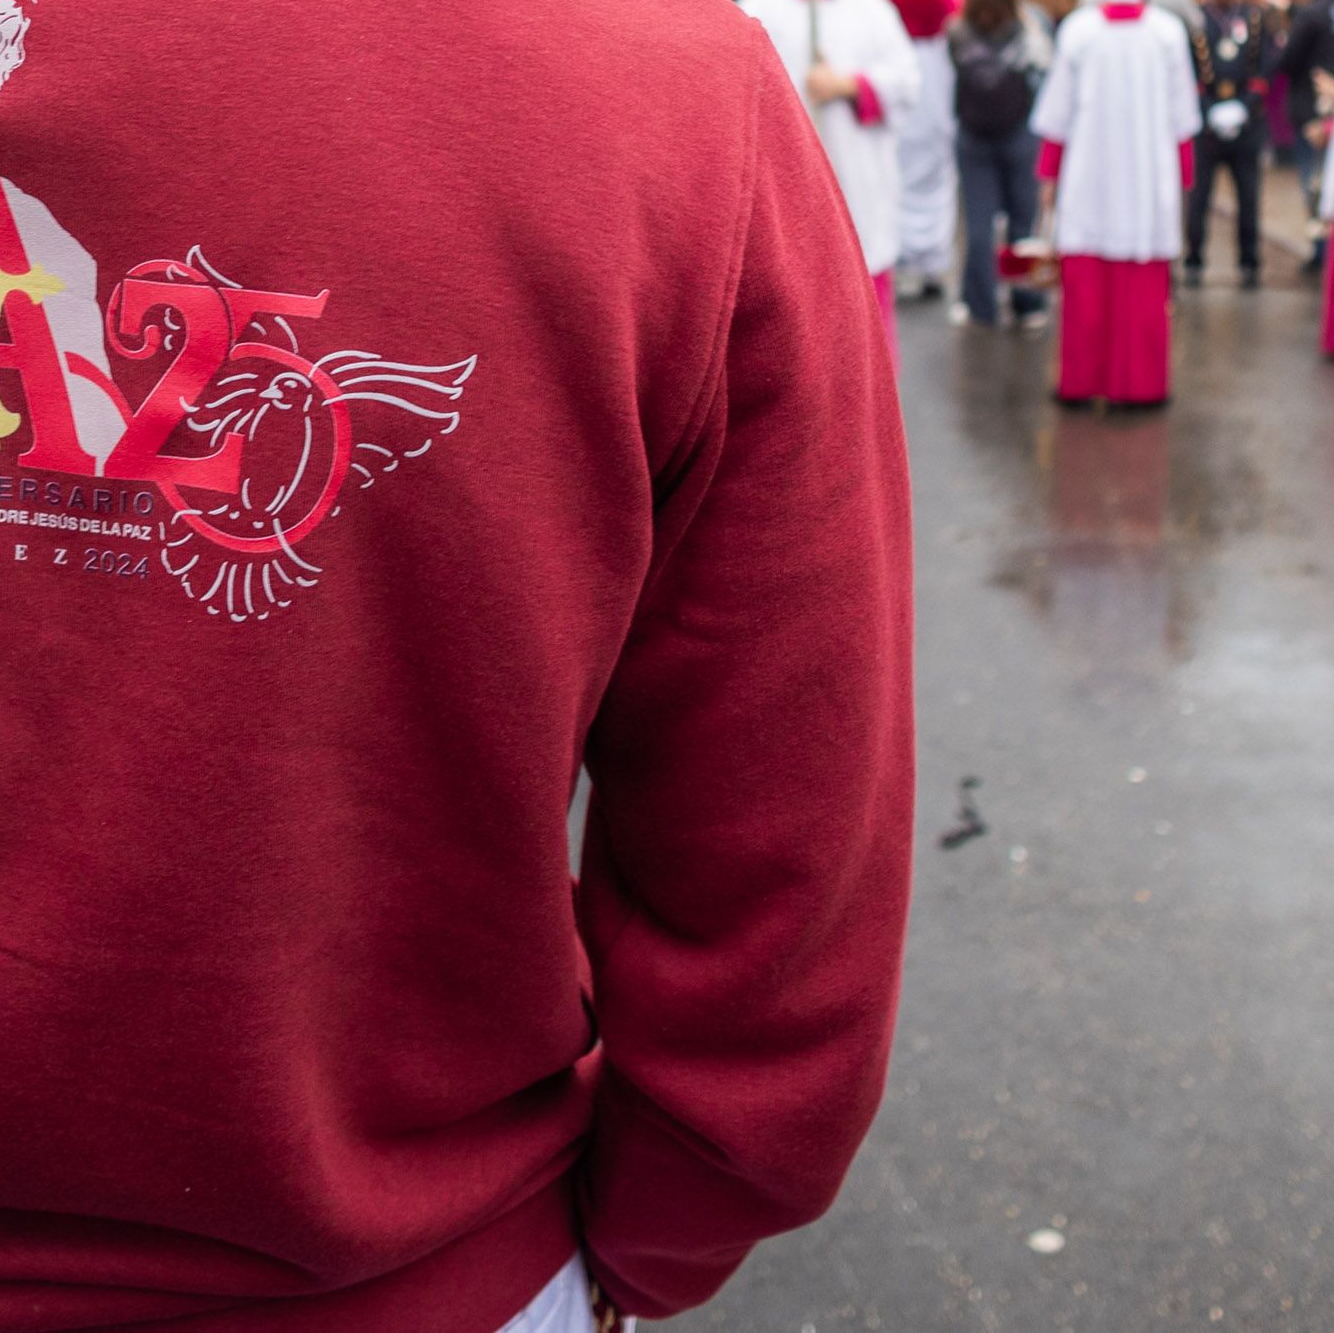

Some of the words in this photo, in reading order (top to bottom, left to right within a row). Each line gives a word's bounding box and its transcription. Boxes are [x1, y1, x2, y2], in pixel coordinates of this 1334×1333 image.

[29, 513, 78, 531] JESÚS
[79, 521, 100, 533] DE
[101, 523, 122, 537] LA
[122, 525, 152, 541] PAZ
[83, 548, 149, 579] 2024
